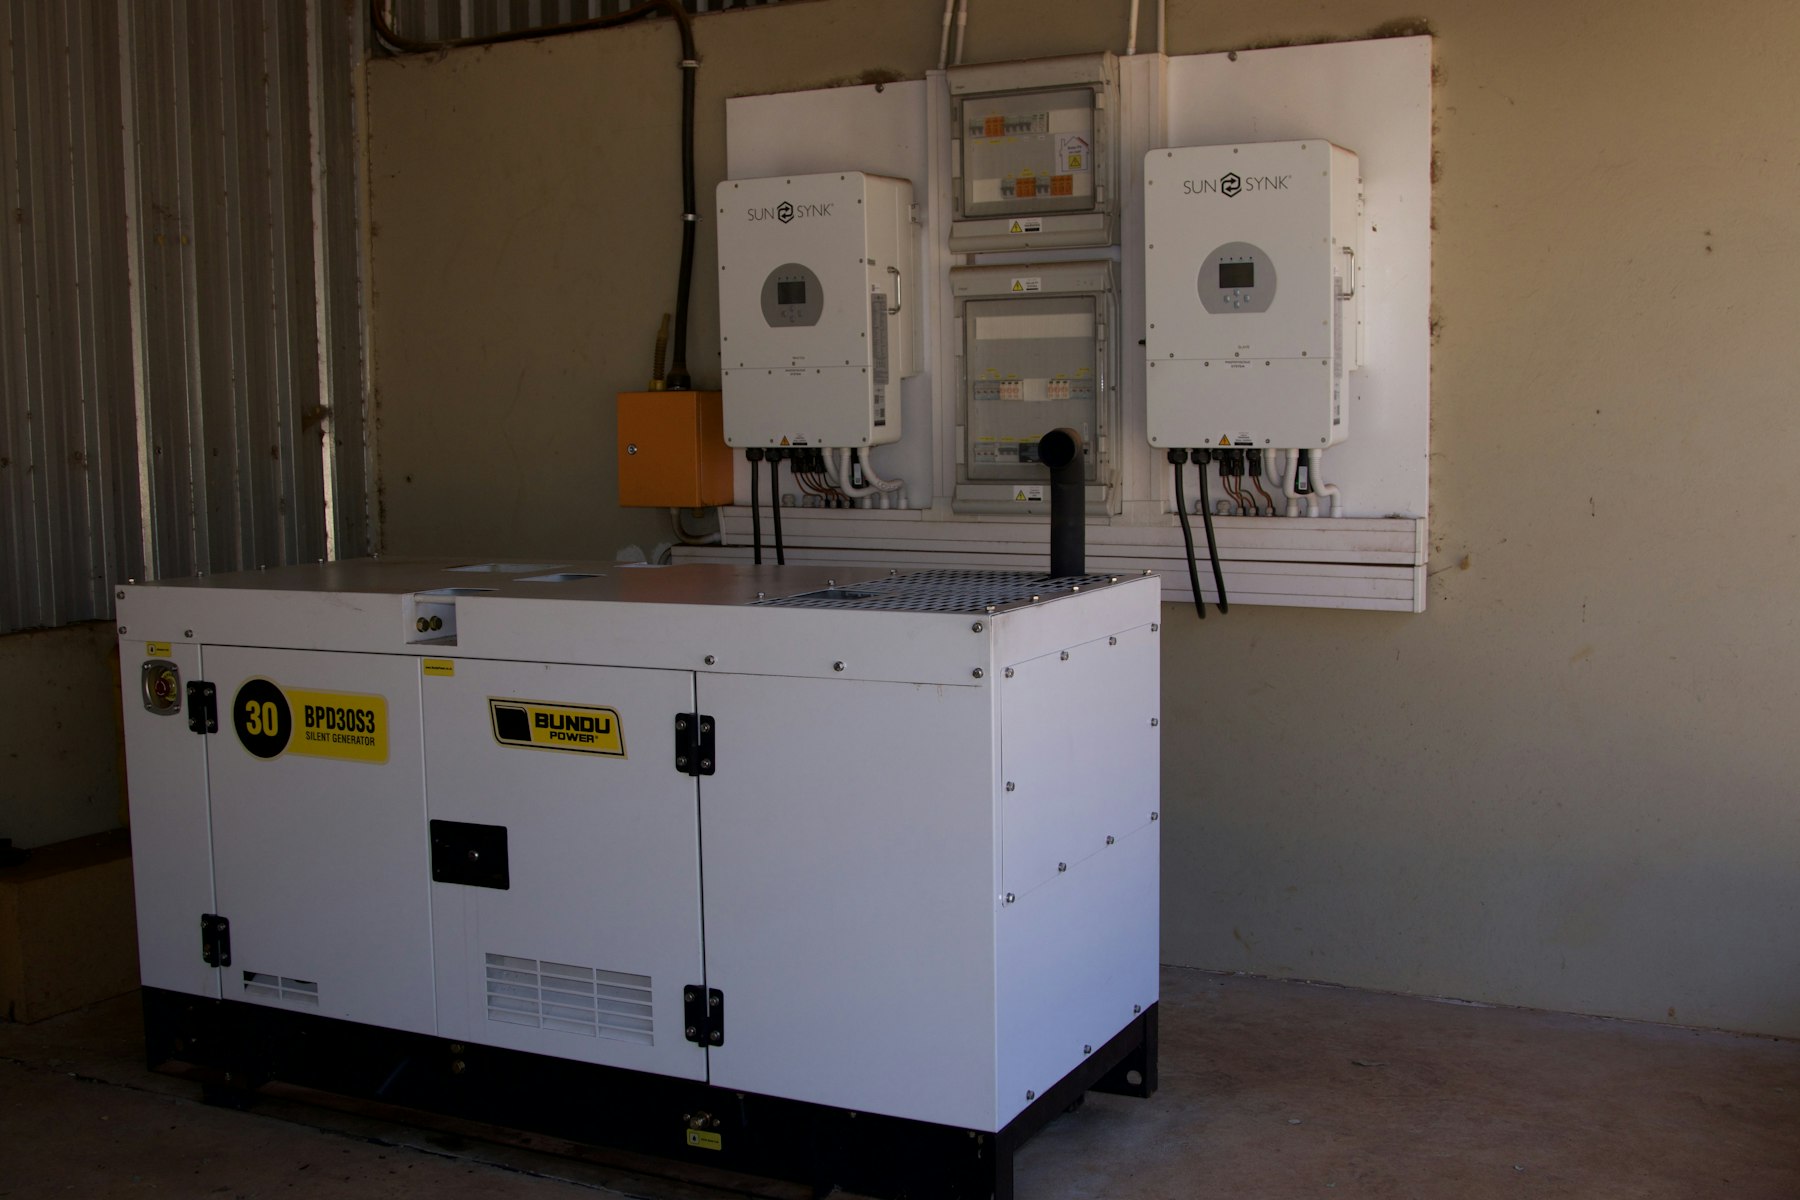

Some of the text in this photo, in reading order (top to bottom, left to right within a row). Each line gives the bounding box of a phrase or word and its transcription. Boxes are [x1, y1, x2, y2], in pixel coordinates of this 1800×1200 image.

[1183, 180, 1216, 194] SUN
[747, 208, 774, 221] SUN
[244, 699, 279, 737] 30
[304, 705, 375, 733] BPD30S3
[535, 712, 610, 733] BUNDU
[305, 731, 375, 746] SILENT GENERATOR
[550, 731, 594, 743] POWER
